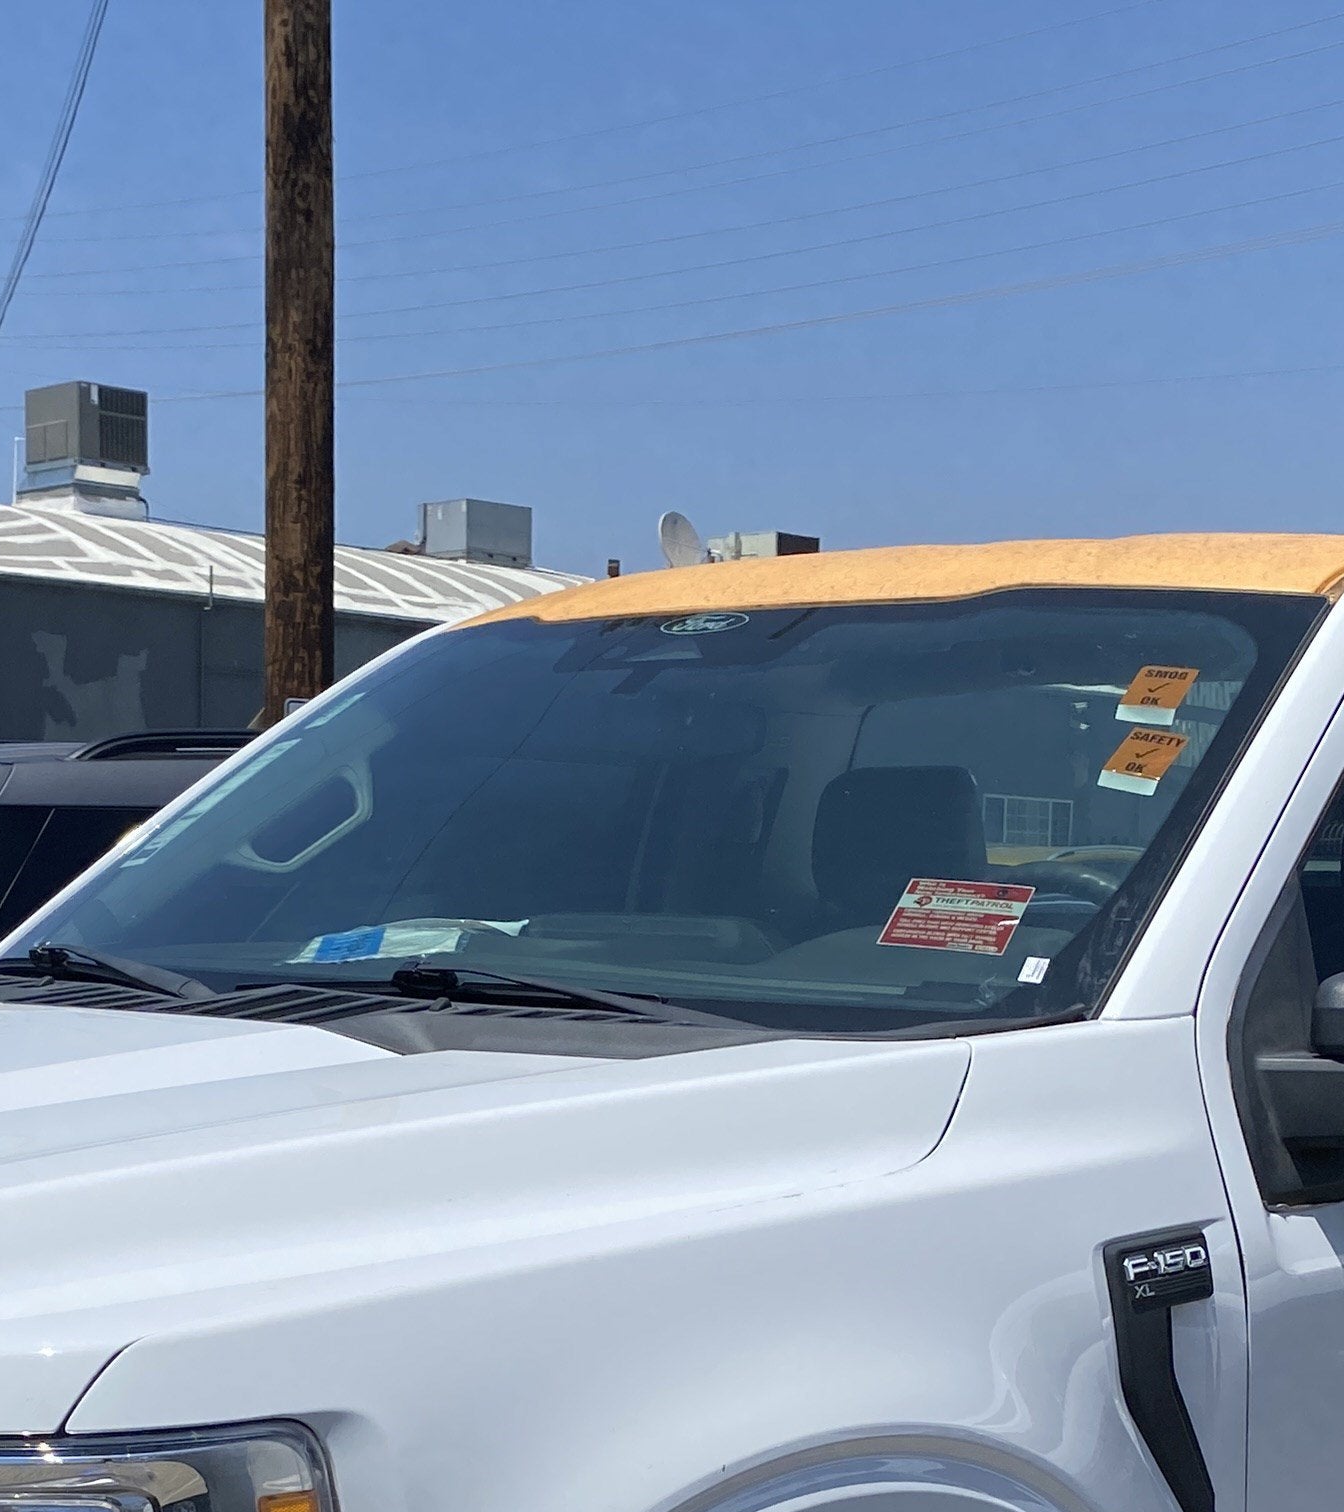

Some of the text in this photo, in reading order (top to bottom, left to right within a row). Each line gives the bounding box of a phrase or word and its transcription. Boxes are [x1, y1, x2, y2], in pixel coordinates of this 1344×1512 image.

[1144, 669, 1189, 680] SMOG
[1140, 696, 1160, 706] OK
[1130, 731, 1186, 747] SAFETY
[1125, 762, 1147, 773] OK
[1123, 1244, 1206, 1281] F-150
[1134, 1283, 1155, 1299] XL
